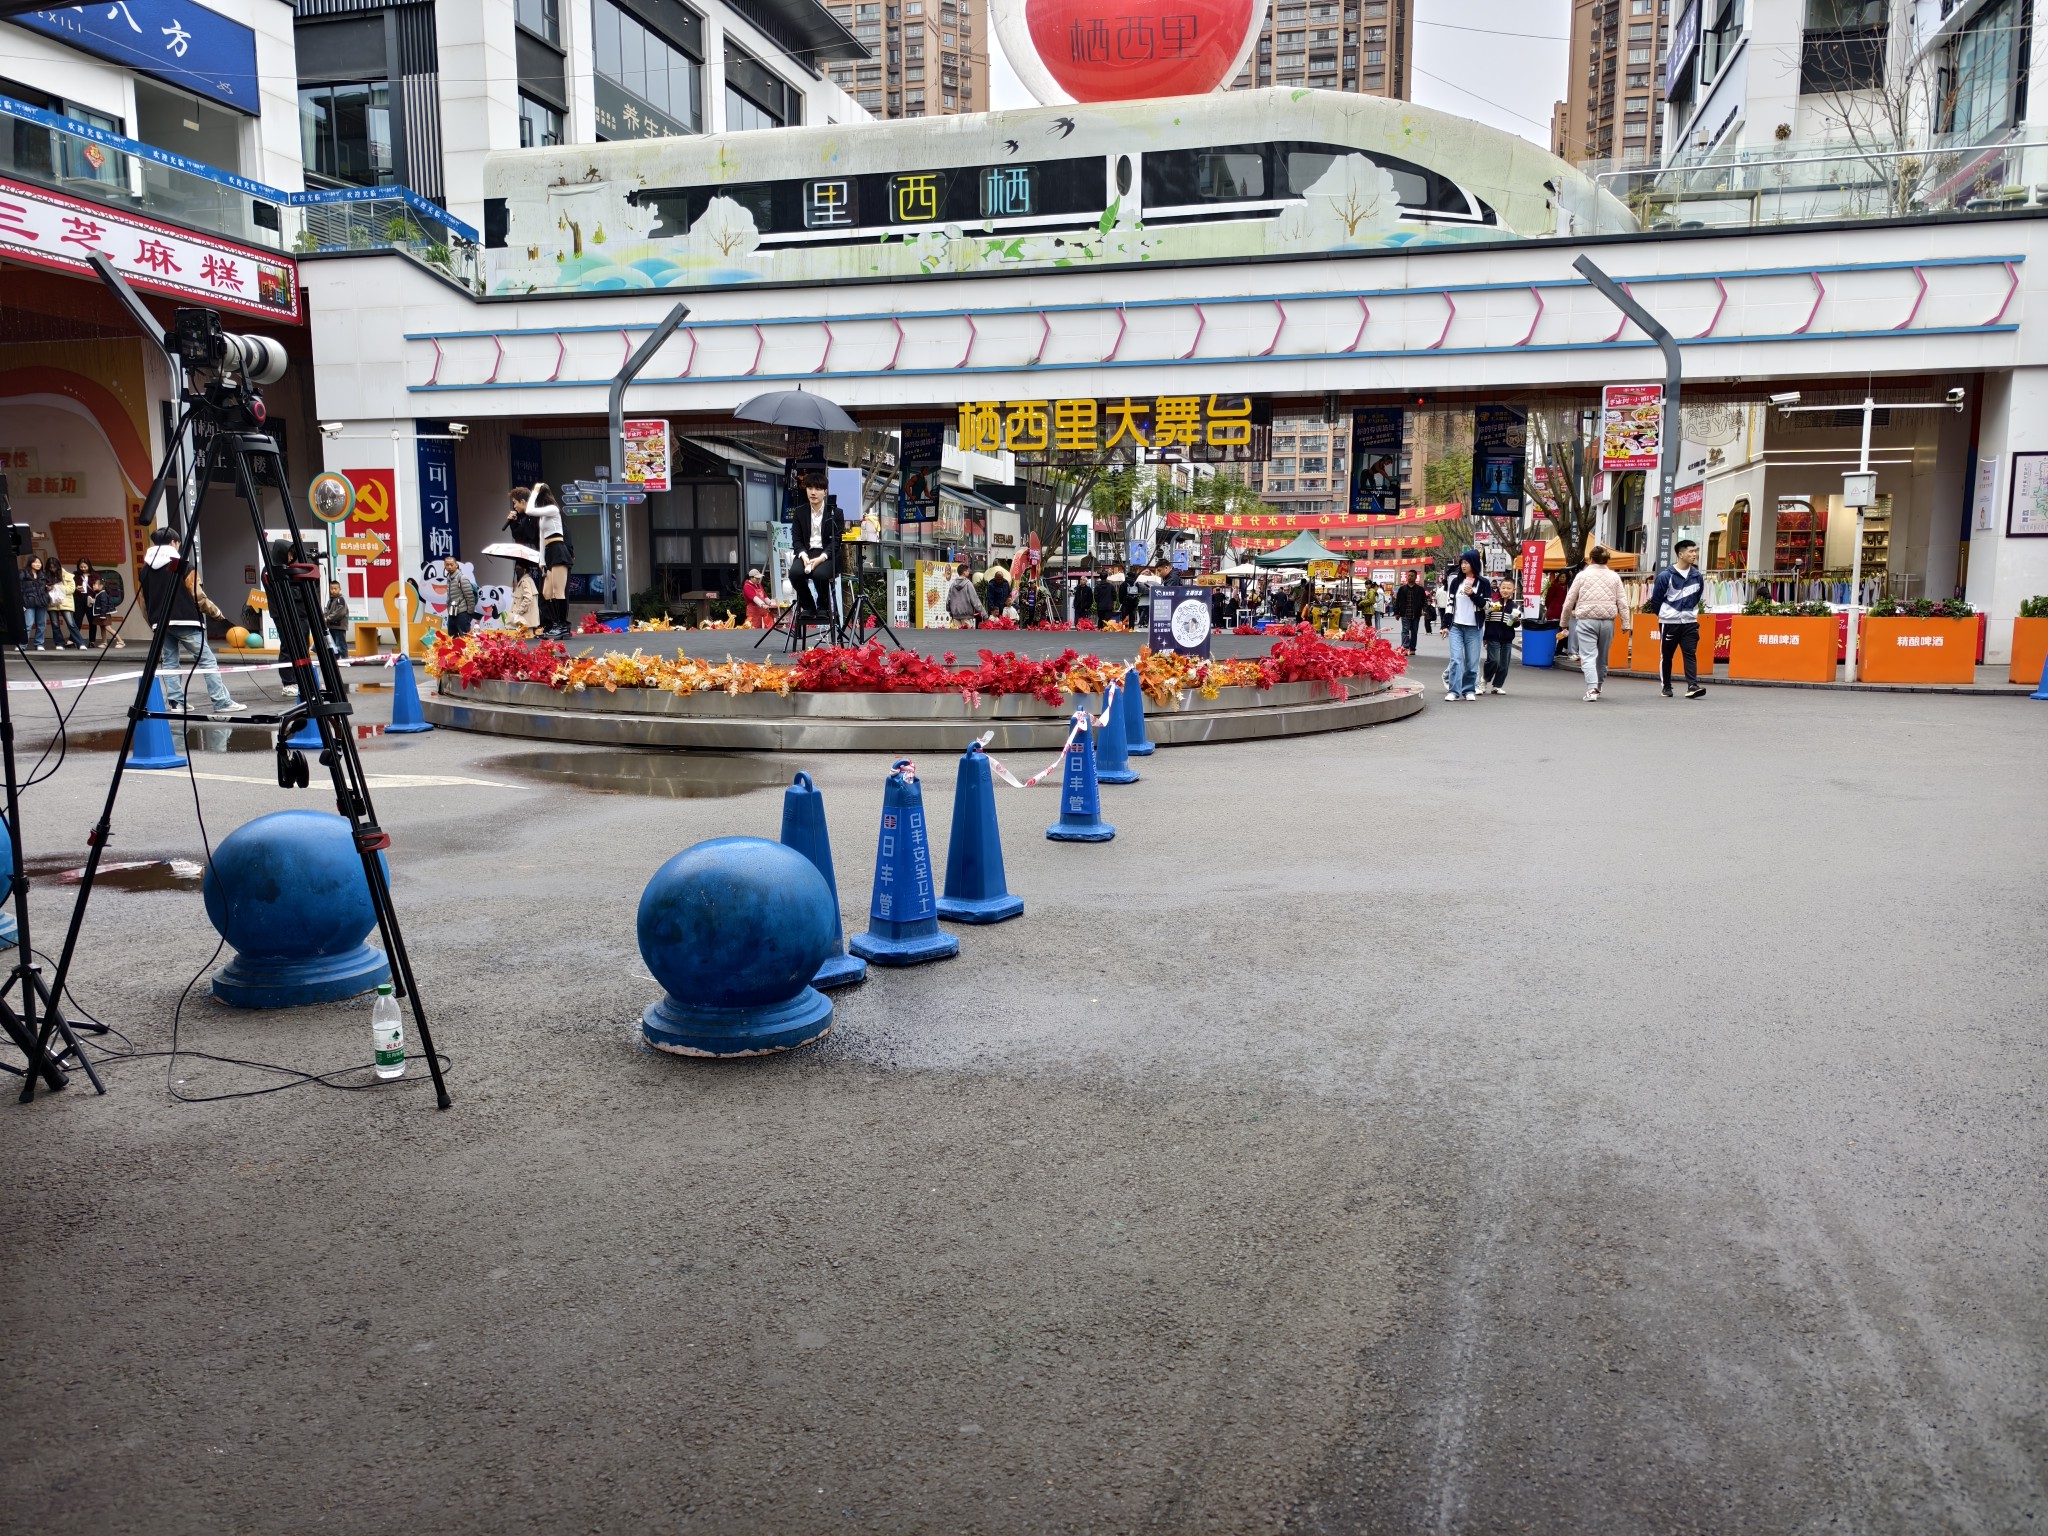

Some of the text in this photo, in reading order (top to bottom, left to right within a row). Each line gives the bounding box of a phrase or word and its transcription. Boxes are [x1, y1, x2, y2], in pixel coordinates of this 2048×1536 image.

[1069, 14, 1200, 63] 栖西里
[811, 168, 1031, 225] 里 西 栖
[0, 202, 245, 294] 三芝麻糕
[958, 393, 1252, 452] 栖西里大舞台
[1758, 634, 1800, 645] 精酿啤酒
[1897, 636, 1944, 647] 精酿啤酒
[1069, 756, 1084, 811] 日丰管
[880, 835, 895, 916] 日丰管
[909, 812, 931, 914] 日丰安全卫士
